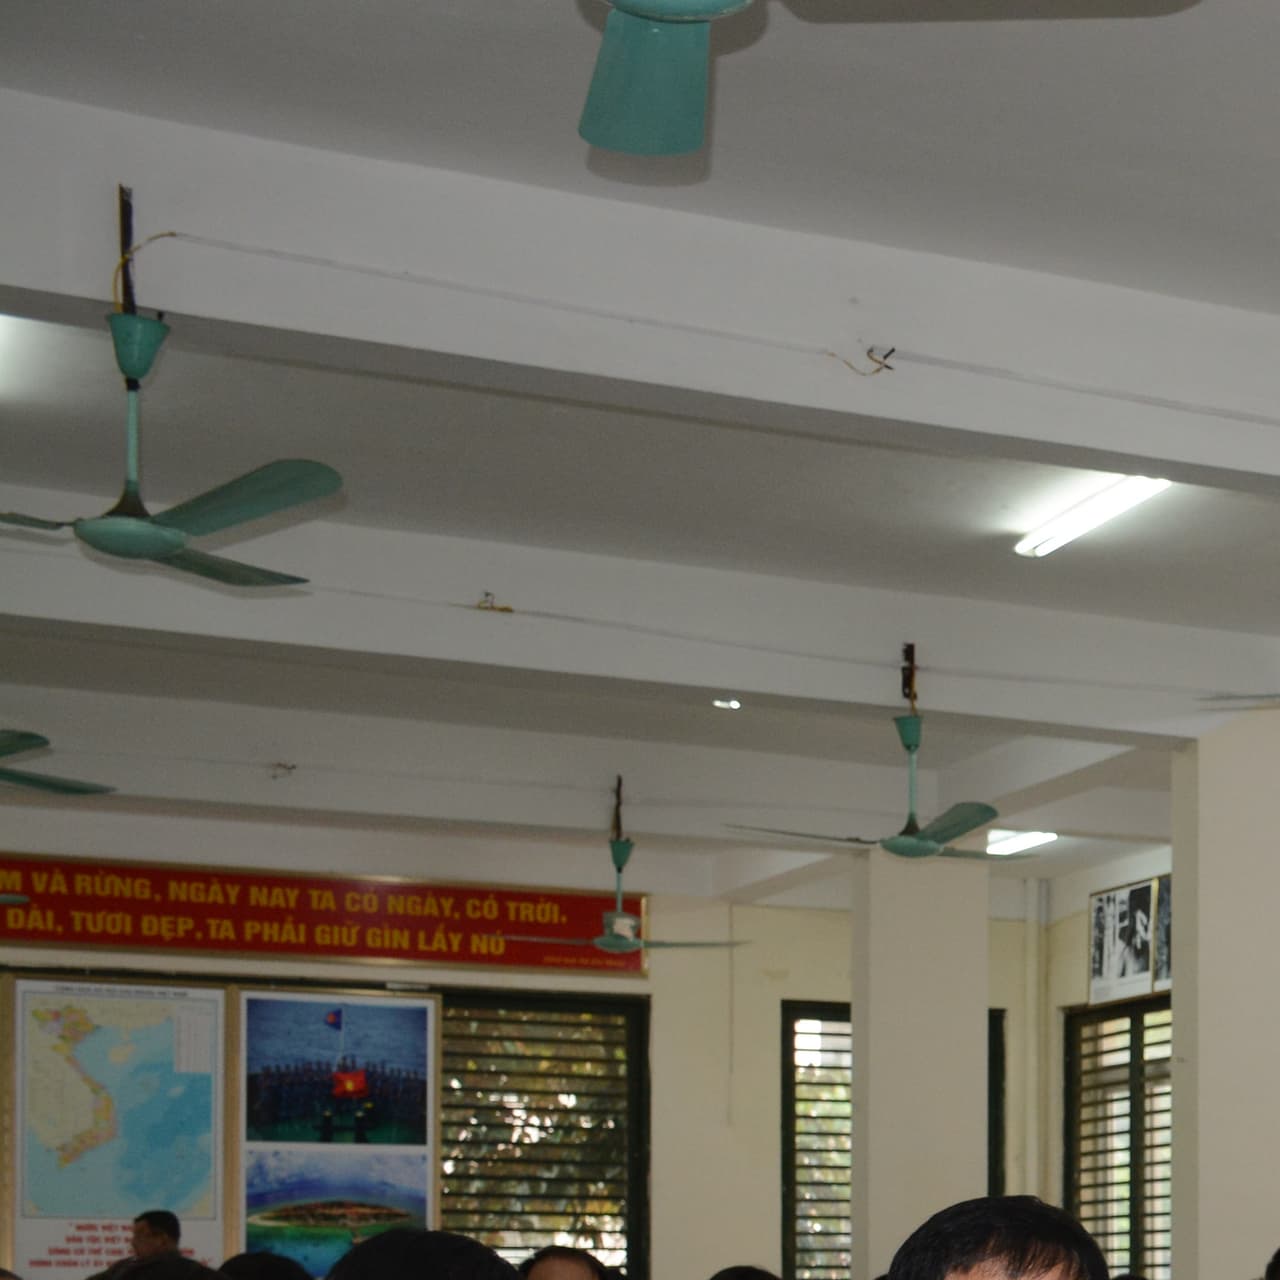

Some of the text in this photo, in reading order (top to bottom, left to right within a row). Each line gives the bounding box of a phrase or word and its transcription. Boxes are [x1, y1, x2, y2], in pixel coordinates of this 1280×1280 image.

[31, 868, 68, 895] VÀ
[168, 877, 240, 905] NGÀY
[250, 885, 299, 909] NAY
[308, 889, 337, 912] TA
[345, 888, 379, 913] CÓ
[466, 894, 498, 919] CÓ
[206, 918, 236, 940] TA
[244, 916, 306, 944] PHẢI
[471, 930, 506, 955] NÓ
